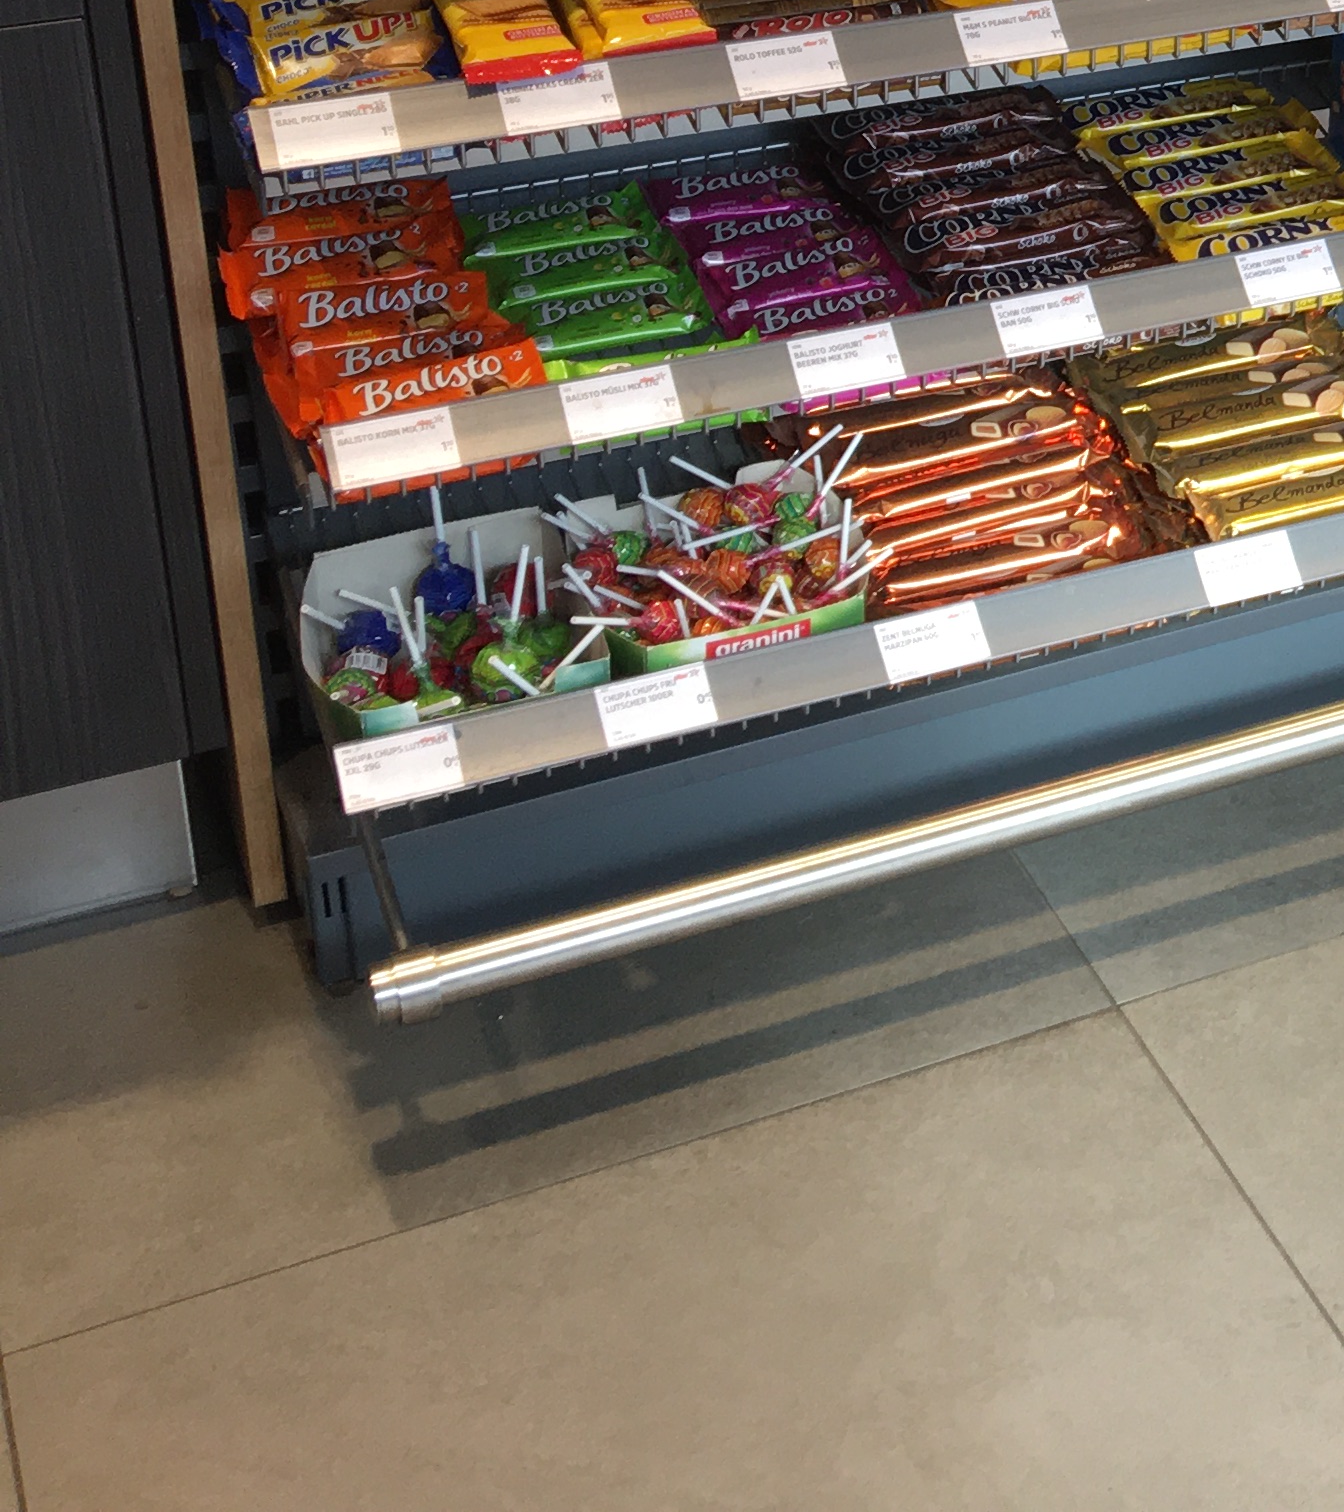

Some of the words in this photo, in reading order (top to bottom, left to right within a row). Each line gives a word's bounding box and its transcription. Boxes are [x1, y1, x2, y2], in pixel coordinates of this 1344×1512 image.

[352, 11, 417, 45] UP!
[733, 51, 757, 62] ROLO
[756, 48, 787, 59] TOFFEE
[301, 114, 323, 124] PICK
[323, 112, 336, 121] UP
[1161, 178, 1286, 224] CORNY
[1196, 201, 1243, 224] BIG
[1017, 231, 1056, 251] Schoko
[298, 278, 450, 328] Balisto
[531, 279, 670, 326] Balisto
[1021, 304, 1046, 316] CORNY
[794, 347, 827, 359] BALISTO
[828, 339, 863, 353] JOGHURT
[796, 355, 827, 368] BEEREN
[827, 352, 843, 363] MIX
[353, 352, 504, 417] Balisto
[565, 390, 601, 403] BALISTO
[601, 385, 627, 397] MÜSLI
[627, 382, 643, 392] MIX
[715, 624, 801, 658] granini
[602, 689, 631, 704] CHUPA
[631, 684, 660, 699] CHUPS
[605, 696, 648, 714] LUTSCHER
